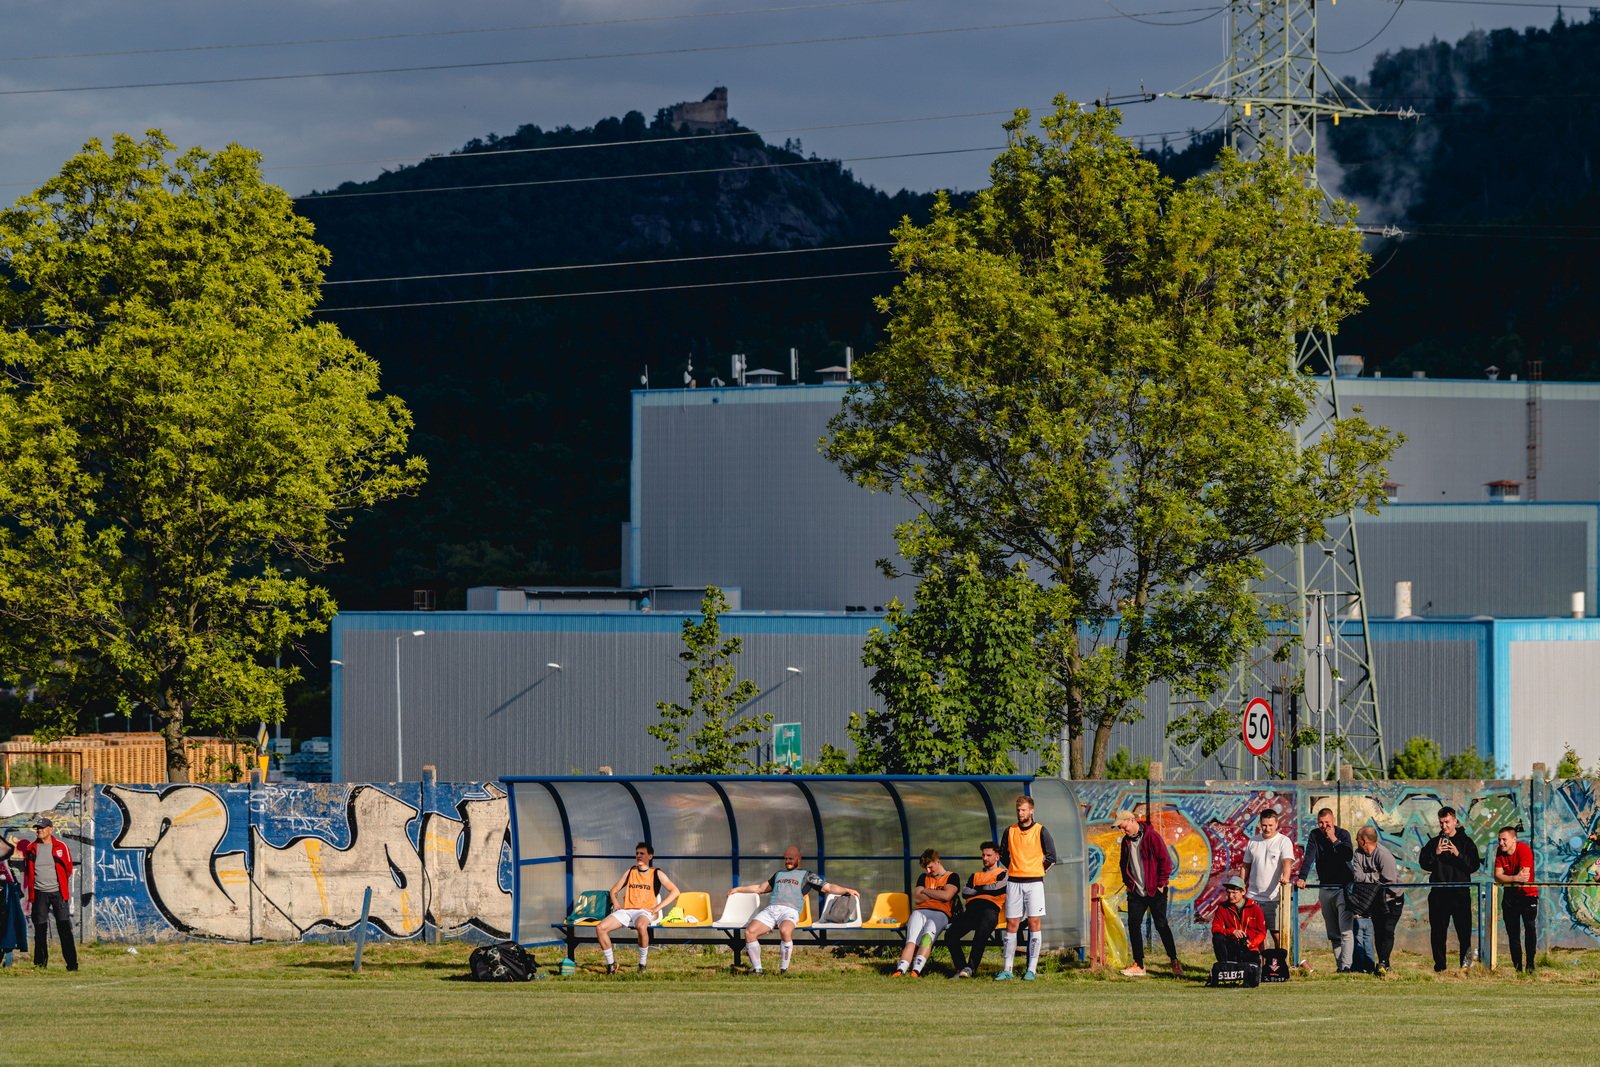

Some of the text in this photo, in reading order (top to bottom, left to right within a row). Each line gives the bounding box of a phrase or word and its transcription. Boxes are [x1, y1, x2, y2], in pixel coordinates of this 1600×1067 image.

[1249, 713, 1270, 740] 50
[575, 895, 597, 915] 21
[1218, 970, 1245, 980] SELECT
